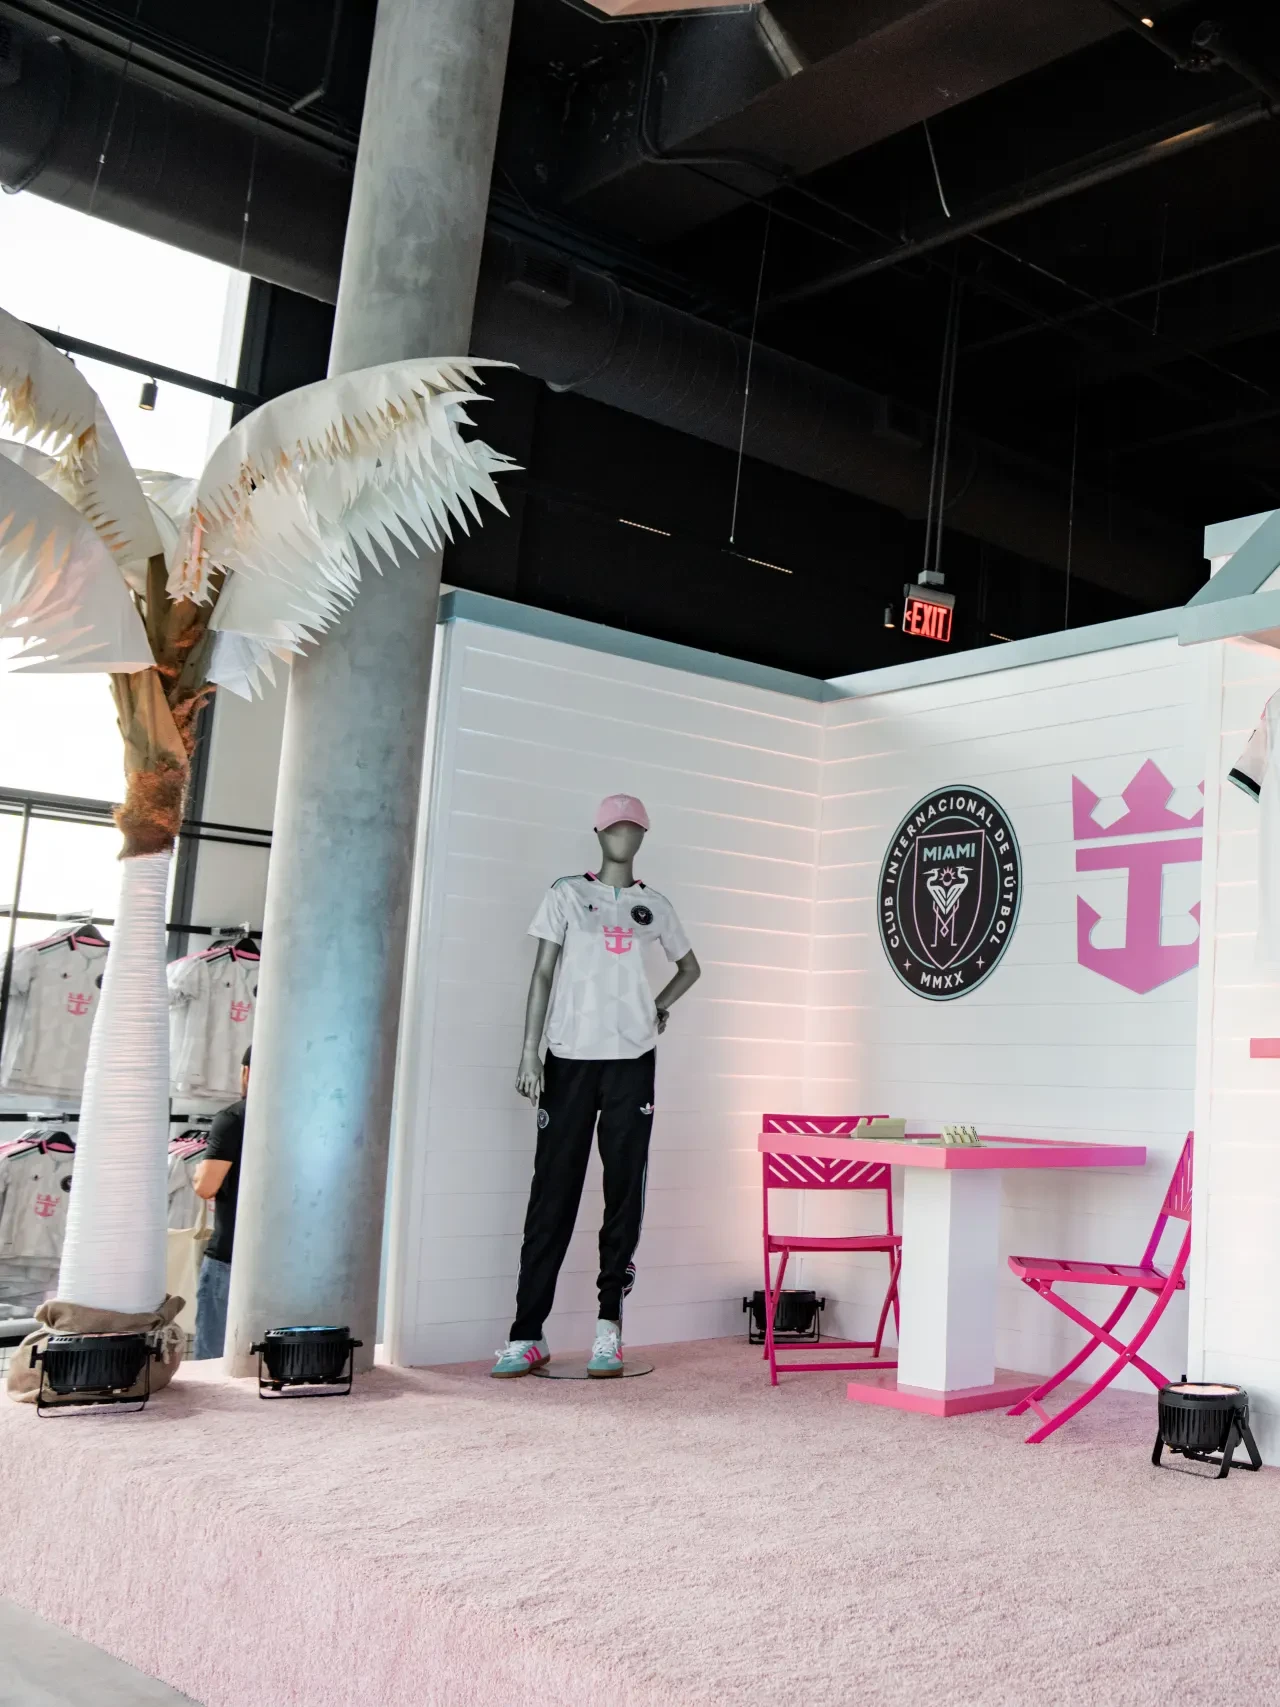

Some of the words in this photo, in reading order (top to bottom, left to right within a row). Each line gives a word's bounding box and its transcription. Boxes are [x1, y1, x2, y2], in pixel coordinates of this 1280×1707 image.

[911, 602, 947, 639] EXIT
[886, 797, 994, 884] INTERNACIONAL
[923, 843, 976, 862] MIAMI
[994, 828, 1010, 854] DE
[884, 896, 900, 948] CLUB
[990, 863, 1017, 945] FÚTBOL
[920, 970, 964, 989] MMXX
